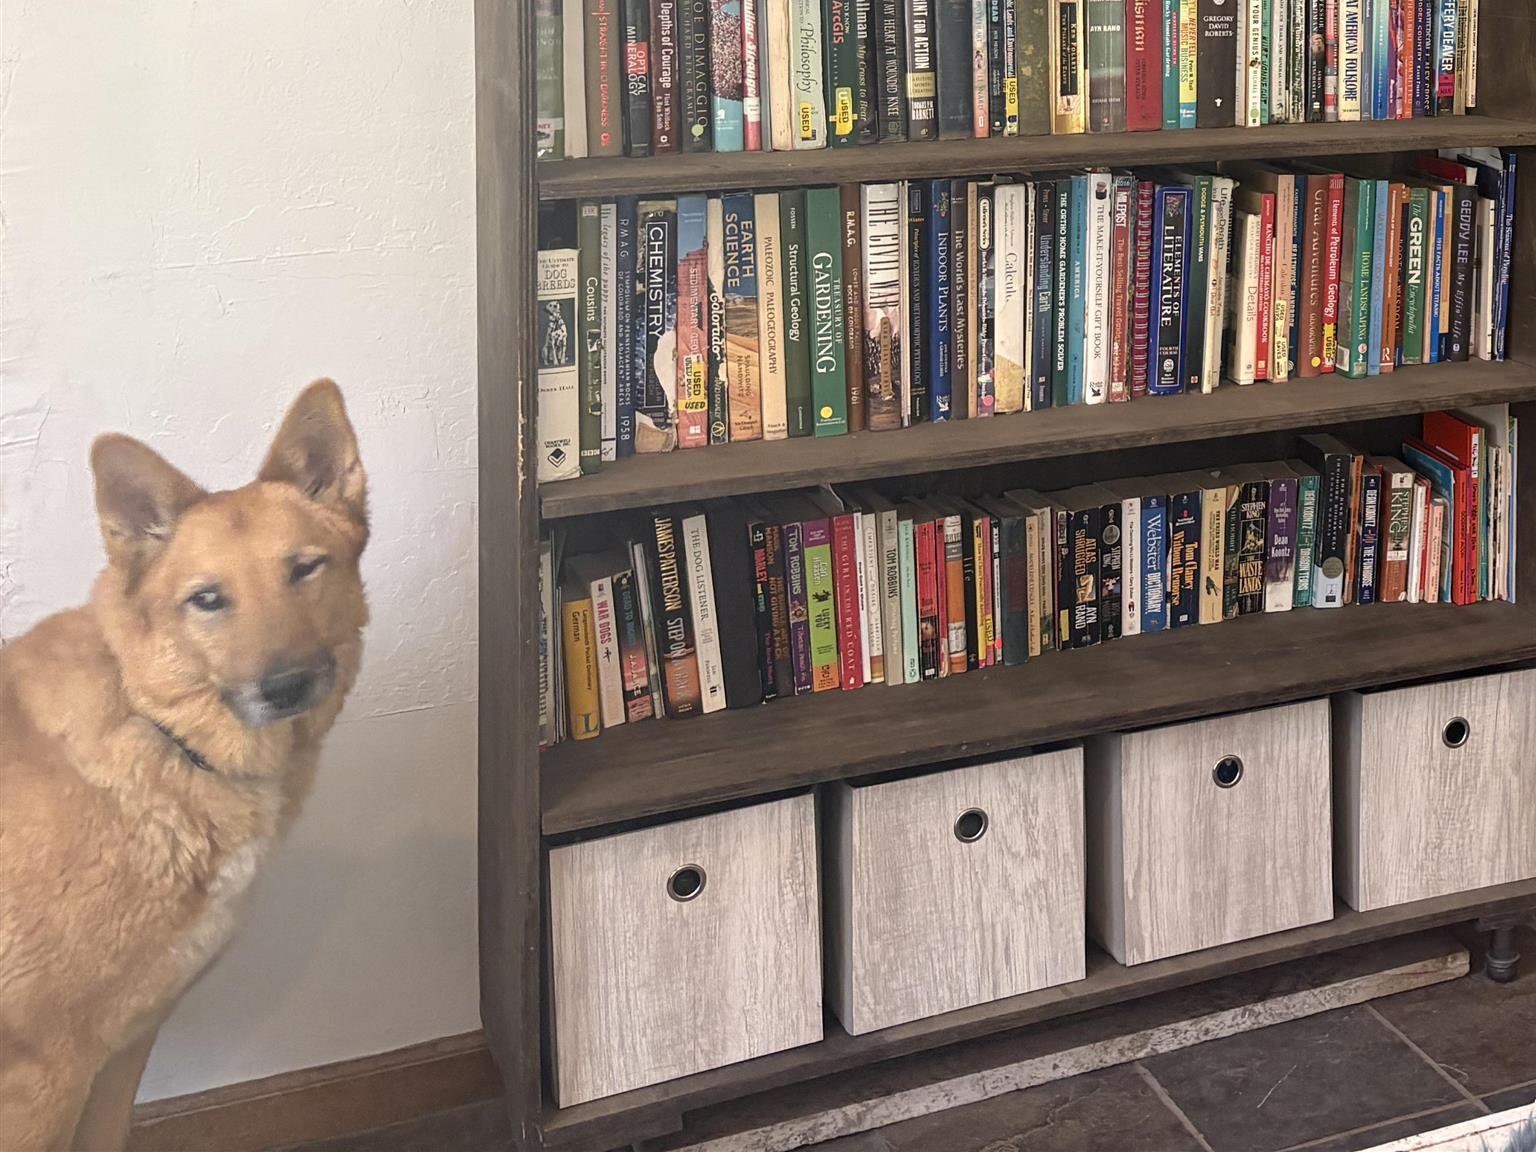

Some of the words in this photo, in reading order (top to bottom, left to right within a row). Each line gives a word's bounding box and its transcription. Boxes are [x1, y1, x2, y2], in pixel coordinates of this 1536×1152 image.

[657, 2, 674, 36] Depths
[831, 0, 845, 45] ArcGIS
[914, 19, 926, 34] FOR
[991, 0, 999, 23] DEAD
[1203, 15, 1235, 23] GREGORY
[1252, 3, 1261, 25] YOUR
[660, 36, 674, 47] of
[1070, 23, 1078, 39] KEN
[1251, 27, 1261, 56] GENIUS
[1344, 10, 1359, 55] AMERICAN
[626, 25, 638, 97] MINERALOGY
[658, 48, 675, 89] Courage
[795, 22, 818, 94] Philosophy
[914, 36, 930, 69] ACTION
[1441, 31, 1453, 72] DEAVER
[636, 50, 647, 96] OPTICAL
[693, 33, 708, 128] DIMAGGIO
[1344, 58, 1359, 102] FOLKLORE
[1008, 80, 1017, 105] USED
[801, 107, 811, 132] USED
[1060, 192, 1068, 207] THE
[1331, 199, 1341, 227] Elements
[955, 229, 966, 248] The
[1059, 208, 1068, 235] ORTHO
[1331, 227, 1340, 235] of
[724, 212, 741, 288] SCIENCE
[740, 219, 755, 278] EARTH
[764, 235, 775, 287] PALEOZOIC
[937, 231, 949, 281] INDOOR
[1037, 233, 1052, 290] Understanding
[1058, 236, 1067, 259] HOME
[1327, 235, 1340, 280] Petroleum
[1361, 250, 1371, 278] HOME
[647, 226, 664, 338] CHEMISTRY
[788, 243, 800, 296] Structural
[955, 249, 966, 292] World's
[1057, 259, 1067, 307] GARDENER'S
[1160, 224, 1175, 328] LITERATURE
[1172, 234, 1183, 298] ELEMENTS
[586, 276, 598, 322] Cousins
[811, 251, 837, 374] GARDENING
[937, 285, 949, 332] PLANTS
[955, 293, 966, 316] Last
[1038, 291, 1051, 313] Earth
[1172, 301, 1181, 318] OF
[1245, 285, 1259, 322] Details
[1324, 282, 1338, 318] Geology
[1357, 279, 1370, 341] LANDSCAPING
[711, 292, 724, 354] Colorado
[765, 291, 778, 375] PALEOGEOGRAPHY
[788, 297, 802, 342] Geology
[1056, 307, 1066, 342] PROBLEM
[954, 317, 966, 370] Mysteries
[1056, 342, 1065, 371] SOLVER
[692, 370, 702, 396] USED
[619, 414, 631, 442] 1958
[1389, 491, 1402, 534] KING
[1400, 490, 1410, 533] STEPHEN
[653, 516, 675, 554] JAMES
[689, 529, 700, 549] THE
[787, 531, 798, 552] TOM
[1074, 528, 1087, 576] SHRUGGED
[1085, 537, 1097, 564] ATLAS
[1146, 513, 1162, 571] Webster
[1171, 530, 1185, 567] Without
[1184, 541, 1198, 560] Tom
[1271, 545, 1291, 559] Koontz
[1273, 534, 1289, 545] Dean
[692, 550, 703, 573] DOG
[886, 548, 898, 564] TOM
[1239, 561, 1263, 577] WASTE
[660, 552, 682, 613] PATTERSON
[789, 555, 802, 595] ROBBINS
[887, 565, 898, 600] ROBBINS
[1148, 571, 1161, 614] DICTIONARY
[1171, 567, 1184, 607] Remorse
[1180, 560, 1198, 590] Clancy
[1238, 576, 1263, 594] LANDS
[596, 599, 608, 620] WAR
[695, 574, 709, 622] LISTENER
[1085, 606, 1097, 624] AYN
[571, 610, 582, 643] German
[599, 620, 611, 645] DOGS
[665, 616, 685, 641] STEP
[1074, 604, 1086, 629] RAND
